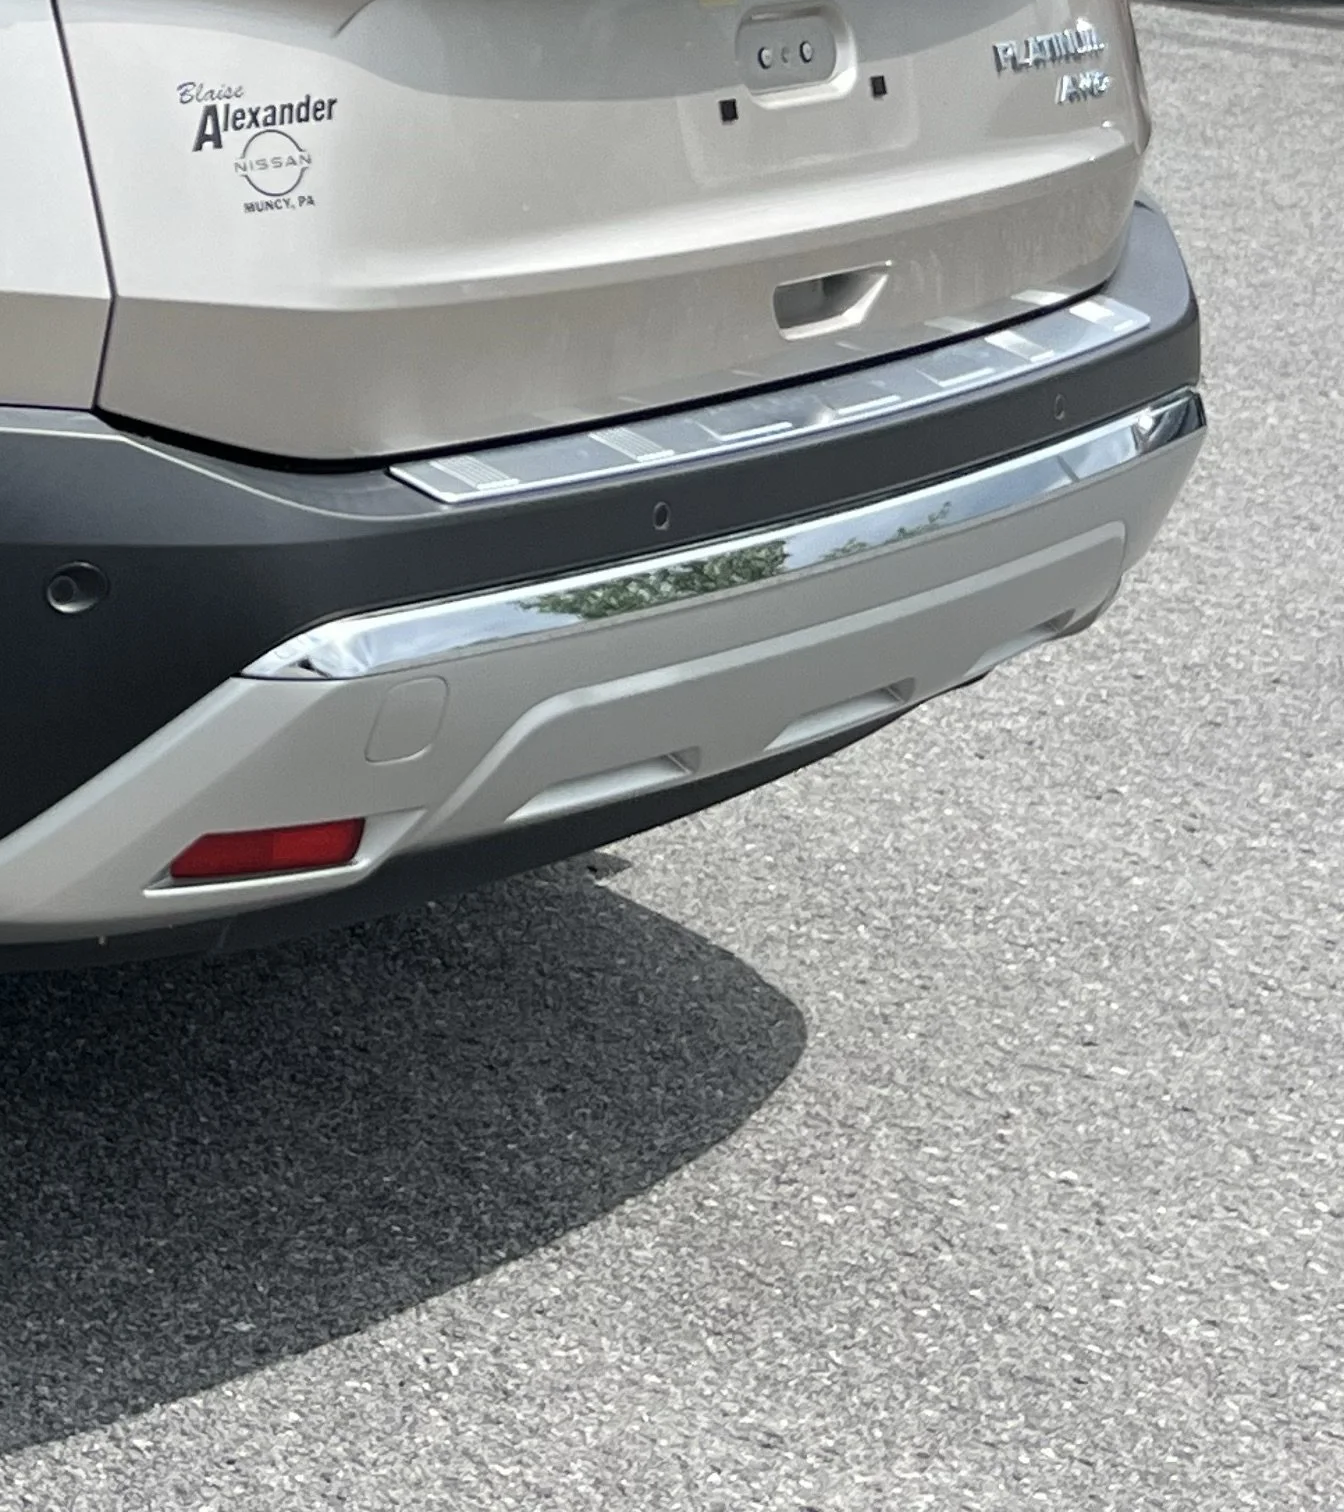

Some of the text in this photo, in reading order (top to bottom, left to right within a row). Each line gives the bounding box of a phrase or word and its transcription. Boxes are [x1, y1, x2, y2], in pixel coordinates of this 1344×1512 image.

[176, 81, 244, 105] Blaise
[192, 94, 338, 152] Alexander
[234, 154, 312, 173] NISSAN
[243, 195, 316, 214] MUNCY, PA
